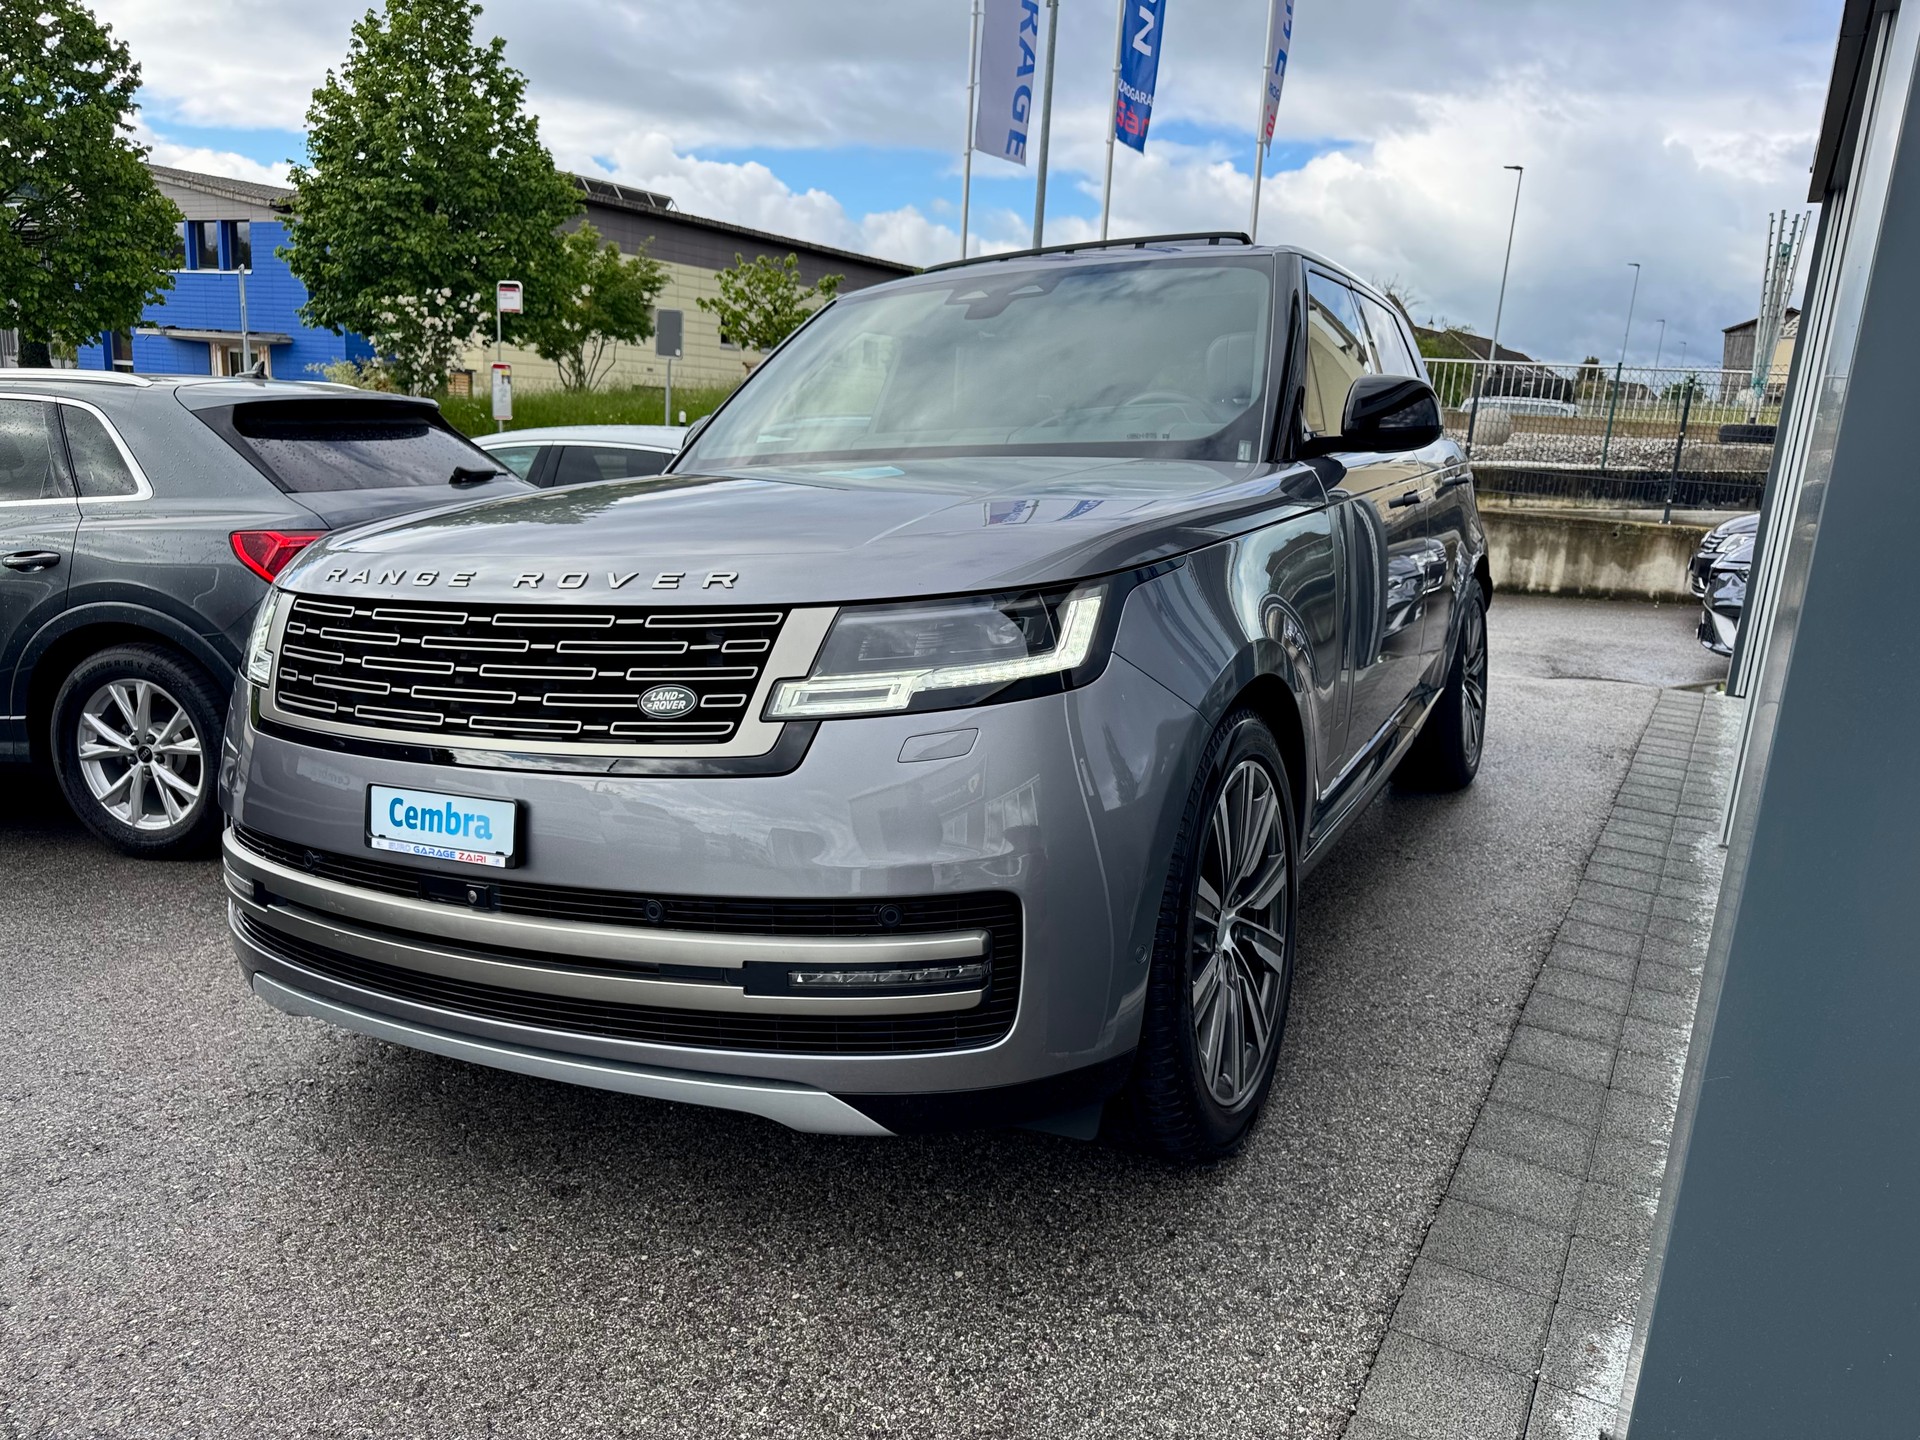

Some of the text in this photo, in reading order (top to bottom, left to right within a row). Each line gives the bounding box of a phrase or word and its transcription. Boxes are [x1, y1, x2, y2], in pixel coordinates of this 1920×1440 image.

[324, 567, 739, 591] RANGE ROVER
[651, 691, 678, 701] LAND
[652, 700, 686, 710] ROVER
[389, 797, 493, 840] Cembra
[388, 841, 487, 864] EURO GARAGE ZAIRI
